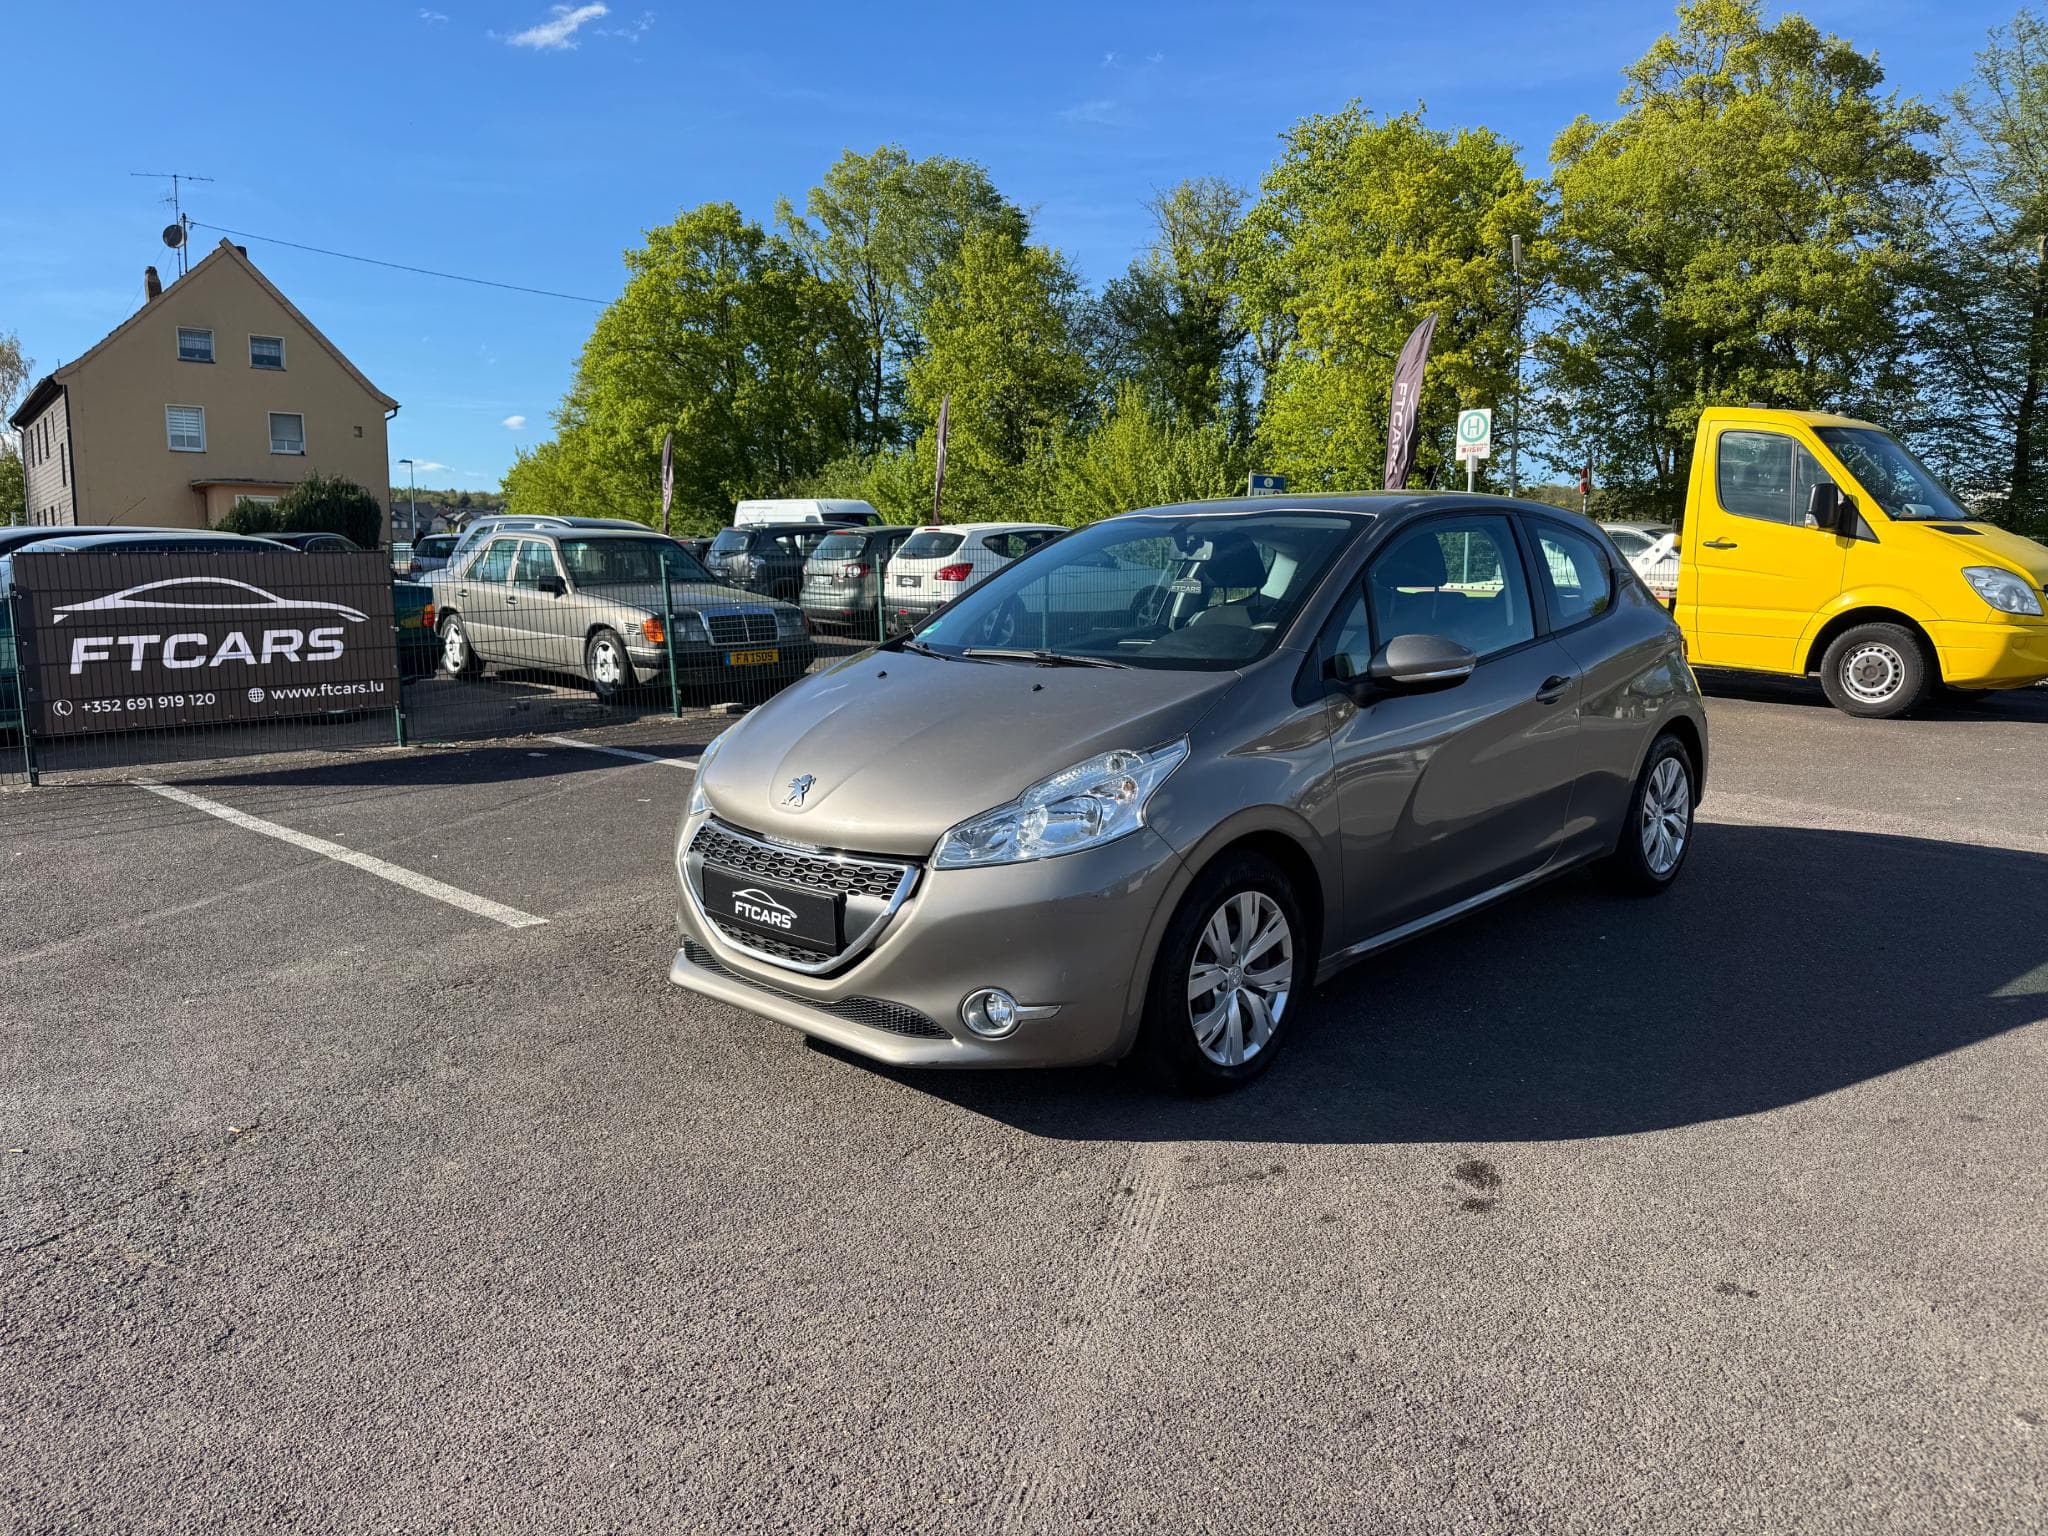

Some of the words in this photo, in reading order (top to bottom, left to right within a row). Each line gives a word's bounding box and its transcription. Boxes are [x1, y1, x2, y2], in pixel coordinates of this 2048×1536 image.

[69, 626, 345, 675] FTCARS
[81, 699, 123, 714] +352
[126, 697, 153, 712] 691
[158, 694, 185, 709] 919
[188, 692, 216, 707] 120
[270, 680, 385, 701] www.ftcars.lu
[734, 900, 792, 929] FTCARS
